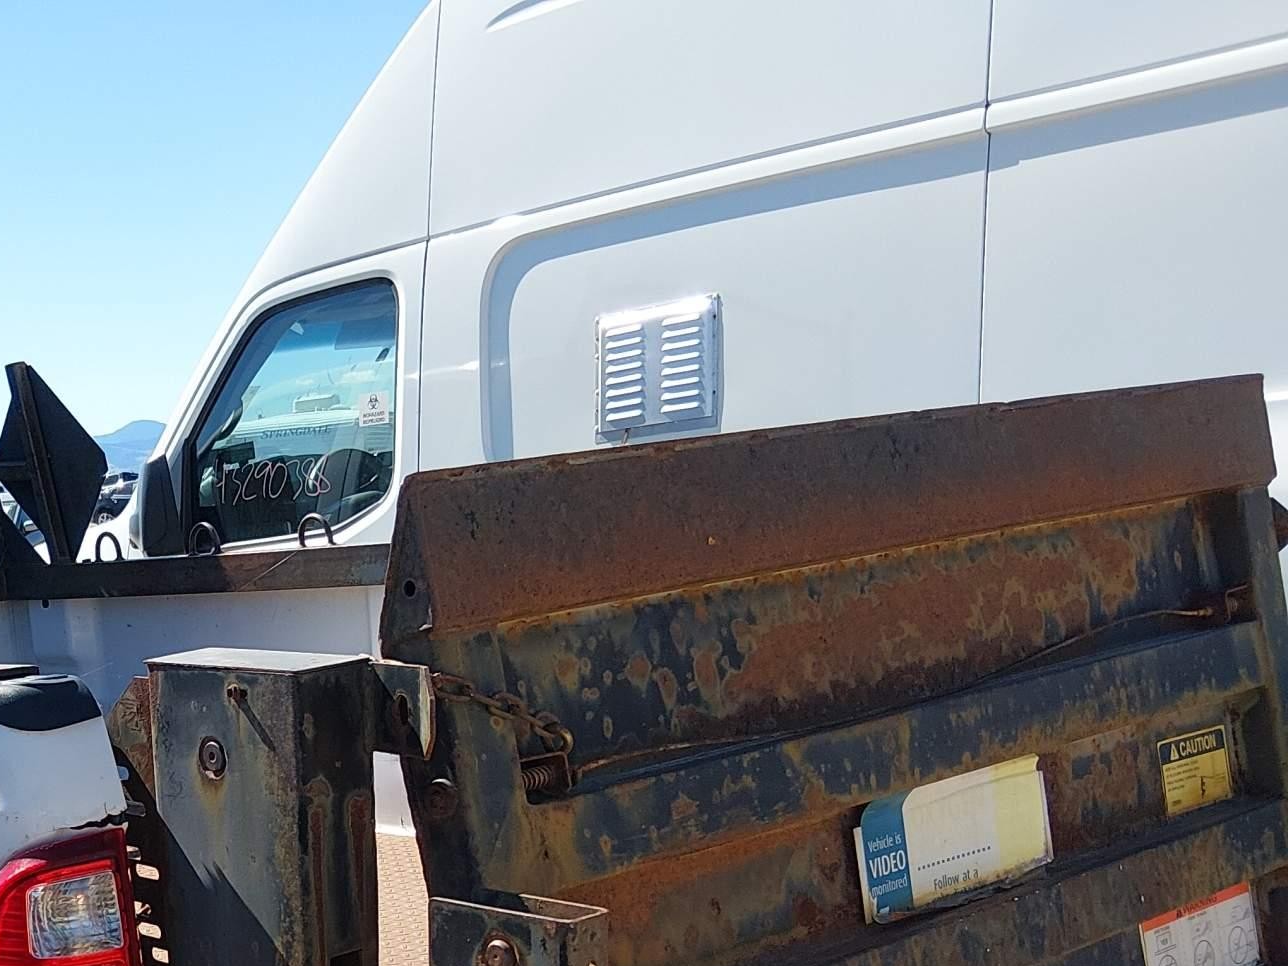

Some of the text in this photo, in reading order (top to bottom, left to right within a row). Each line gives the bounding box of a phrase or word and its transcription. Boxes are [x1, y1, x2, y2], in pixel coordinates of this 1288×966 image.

[1179, 734, 1217, 757] CAUTION
[868, 832, 902, 853] Vehicle is
[869, 850, 906, 879] VIDEO
[871, 875, 908, 898] monitored
[933, 868, 979, 891] Follow at a
